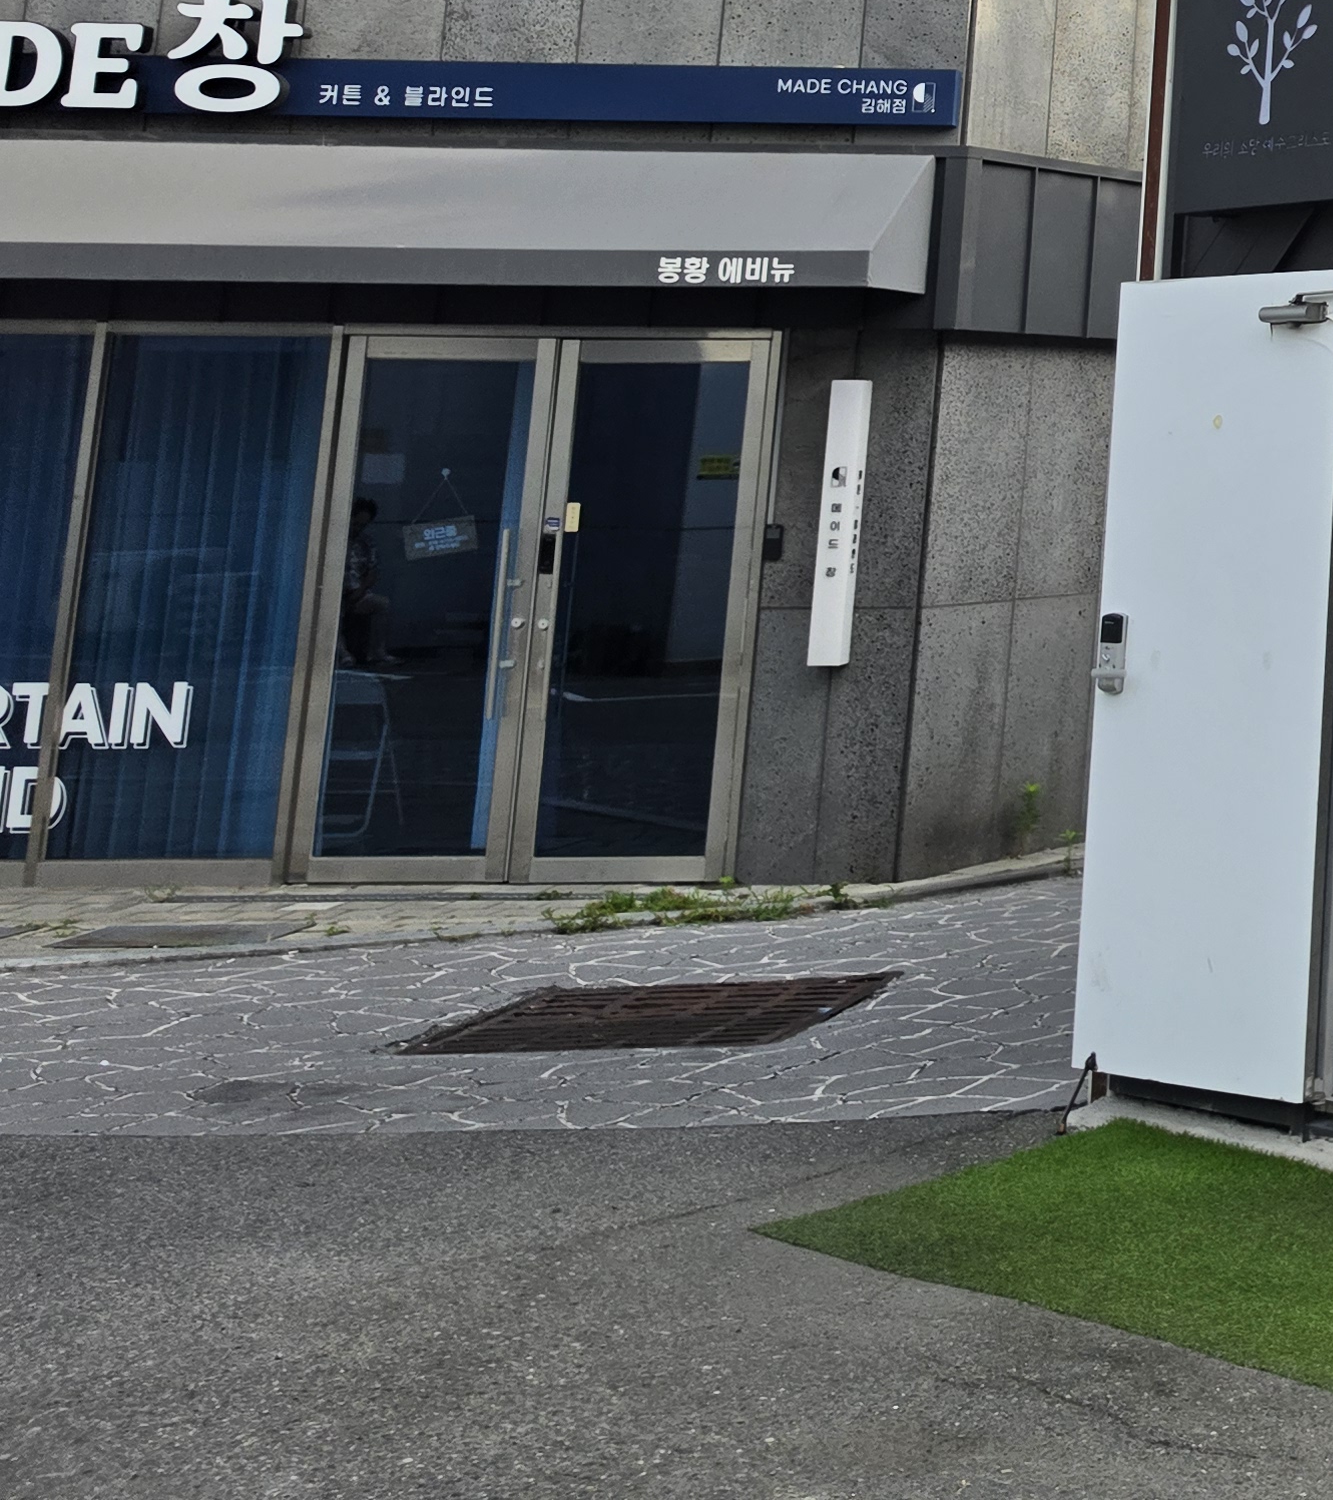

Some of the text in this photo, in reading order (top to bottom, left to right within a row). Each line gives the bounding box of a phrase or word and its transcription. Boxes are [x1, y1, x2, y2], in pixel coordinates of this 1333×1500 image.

[318, 84, 494, 107] 커튼 & 블라인드
[777, 78, 908, 95] MADE CHANG
[861, 98, 907, 114] 김해점
[658, 257, 796, 284] 봉황 에비뉴
[0, 766, 67, 833] D
